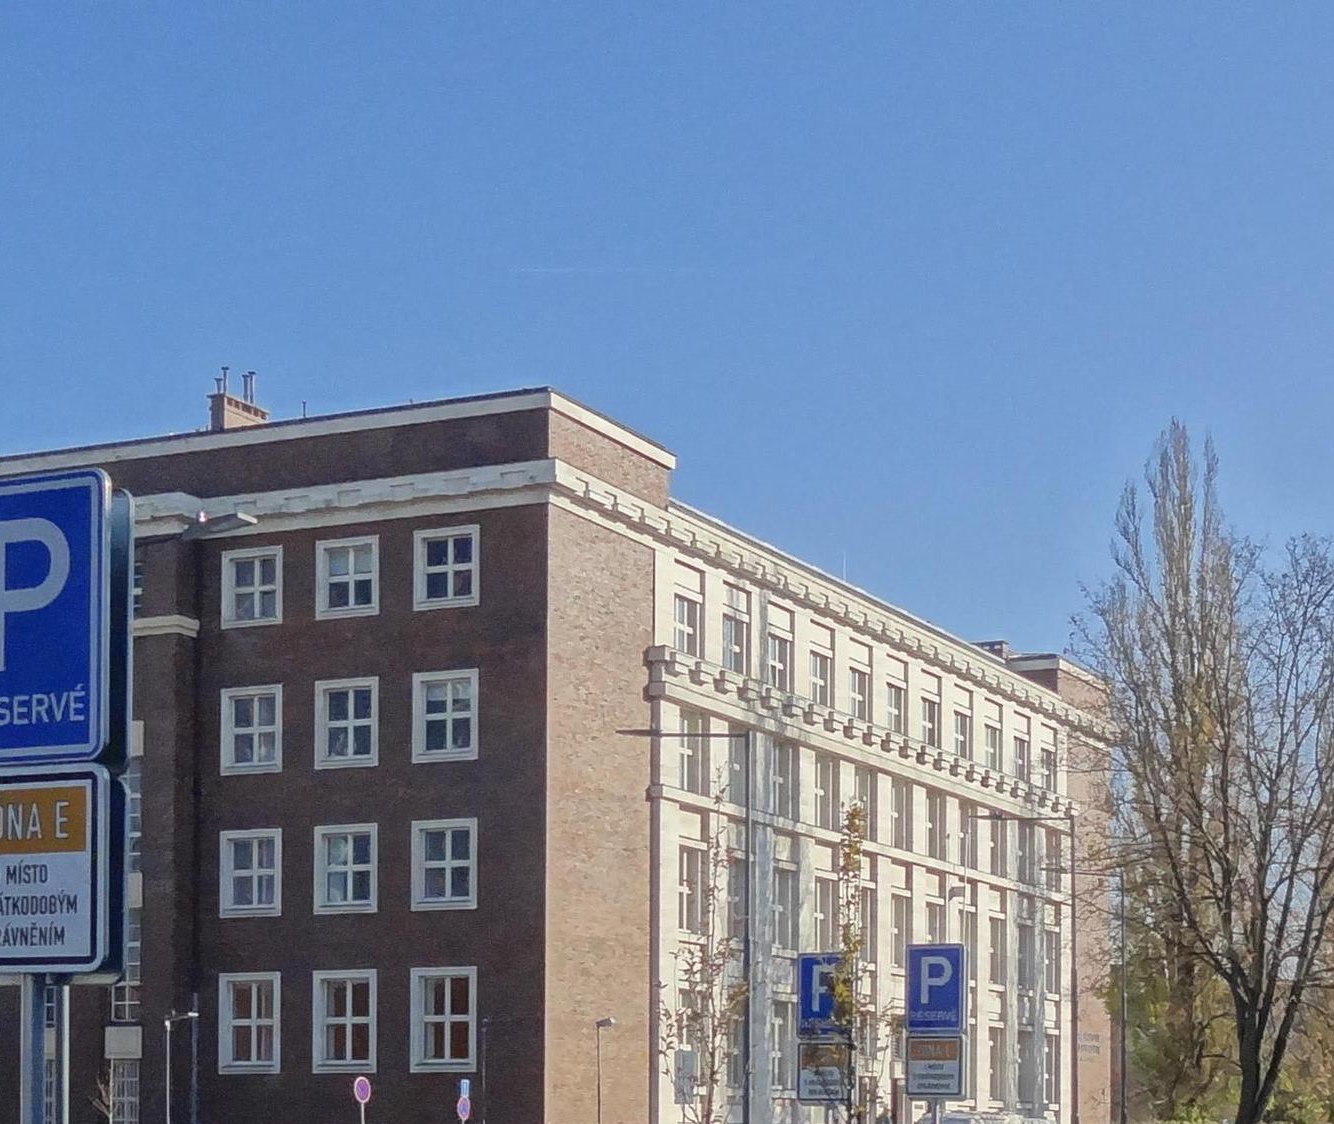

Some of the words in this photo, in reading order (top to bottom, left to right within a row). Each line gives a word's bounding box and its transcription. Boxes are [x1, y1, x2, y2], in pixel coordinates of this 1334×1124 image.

[55, 801, 70, 839] E
[6, 860, 49, 884] MÍSTO
[920, 955, 953, 1004] P
